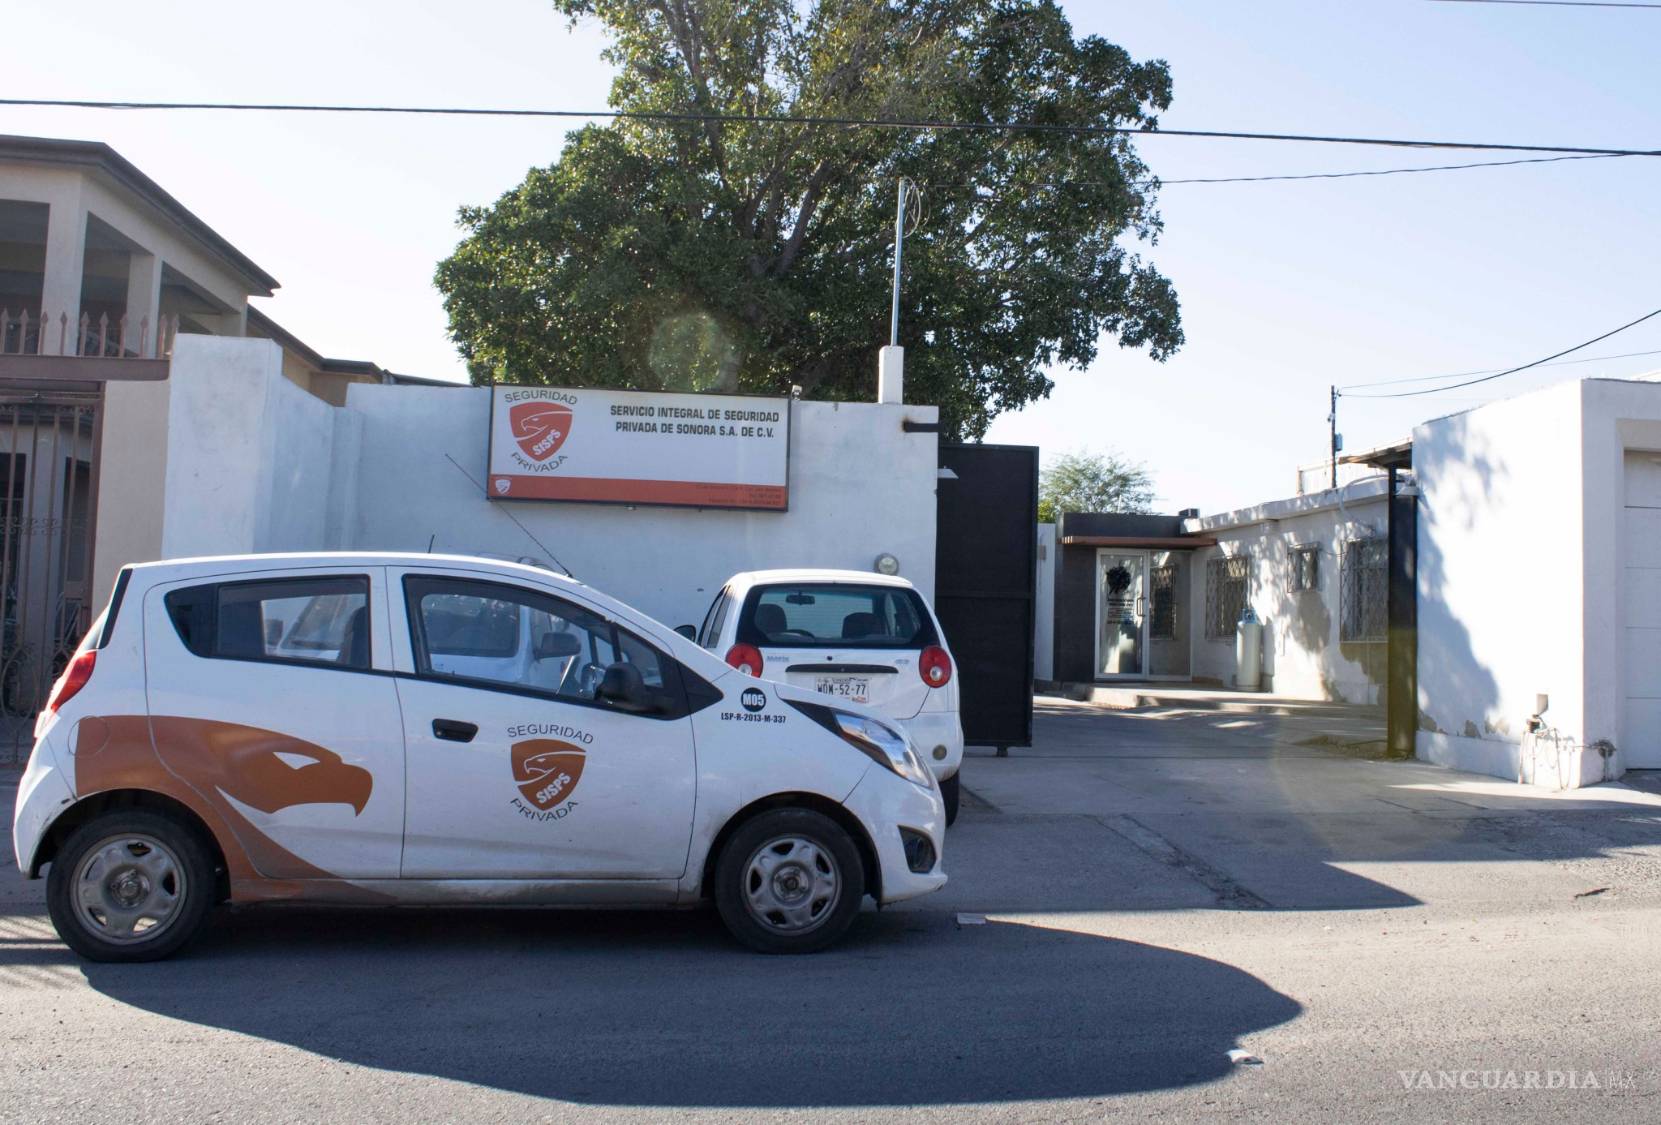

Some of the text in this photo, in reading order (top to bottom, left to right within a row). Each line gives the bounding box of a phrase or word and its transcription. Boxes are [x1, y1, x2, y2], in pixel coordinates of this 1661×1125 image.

[504, 390, 578, 405] SEGURIDAD
[610, 405, 779, 422] SERVICIO INTEGRAL DE SEGURIDAD
[615, 421, 774, 439] PRIVADA DE SONORA S.A. DE C.V.
[532, 428, 561, 455] SISPS
[511, 451, 568, 472] PRIVADA
[743, 693, 765, 706] M05
[507, 723, 594, 744] SEGURIDAD
[535, 772, 571, 804] SISPS
[510, 797, 579, 822] PRIVADA
